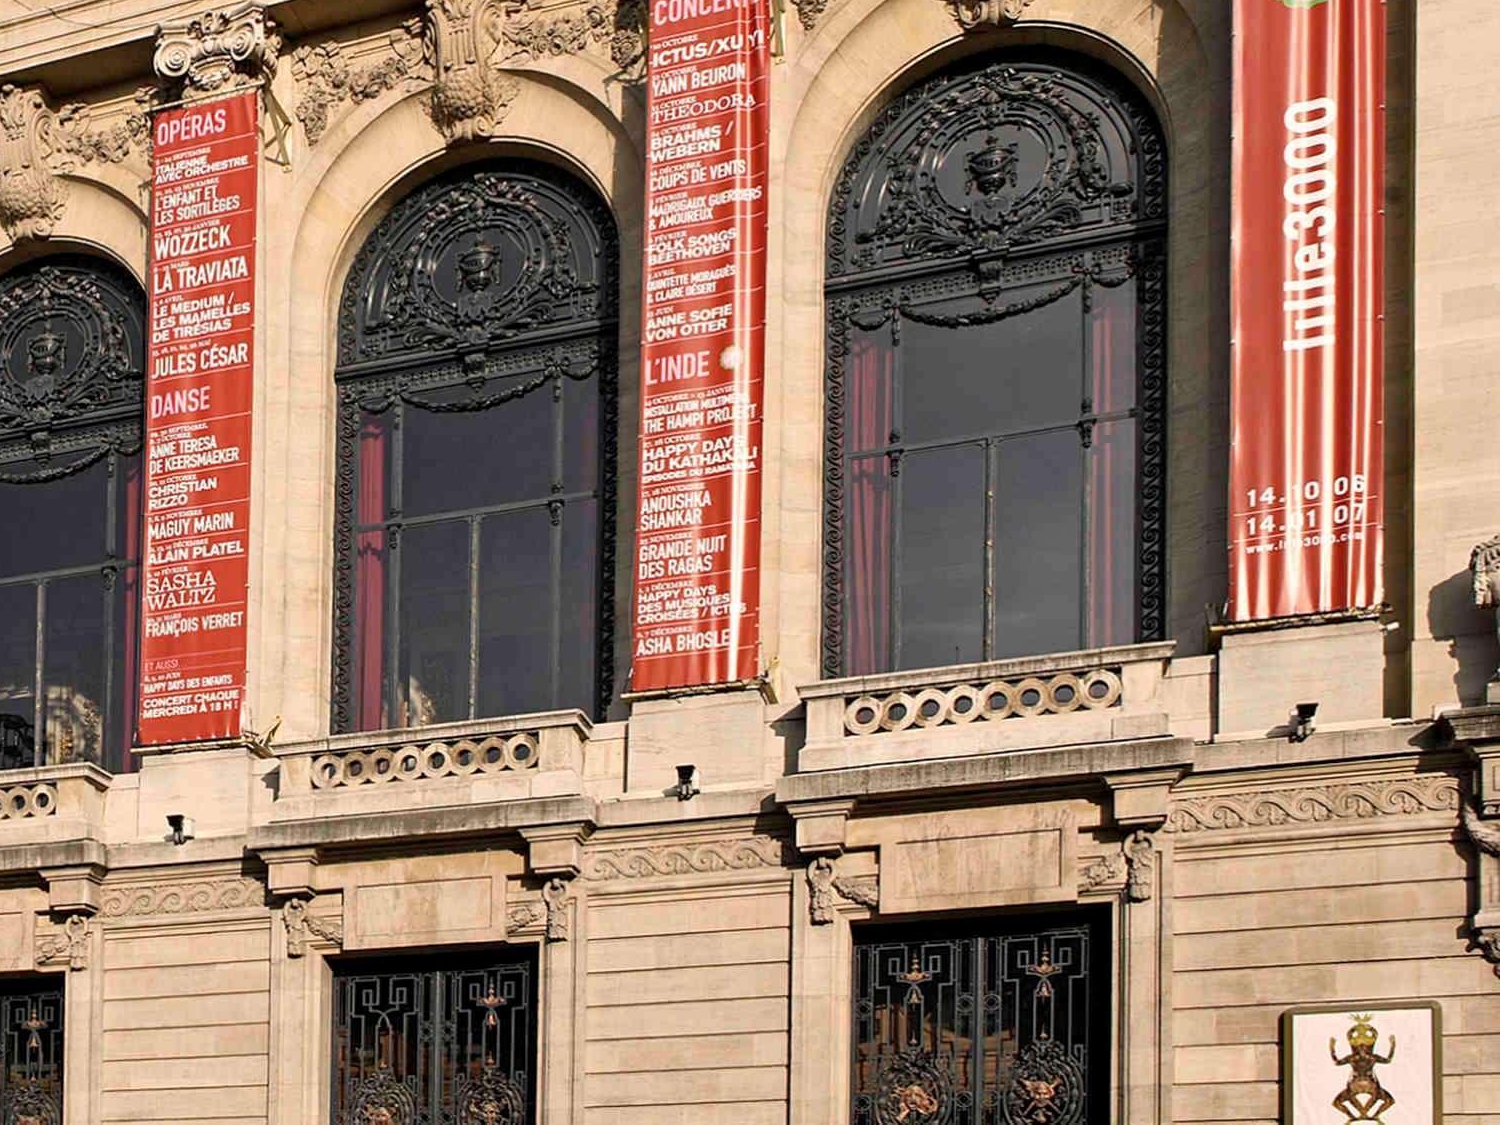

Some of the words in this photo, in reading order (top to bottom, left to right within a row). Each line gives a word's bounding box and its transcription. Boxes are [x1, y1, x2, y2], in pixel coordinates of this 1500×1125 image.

[652, 74, 688, 97] YANN
[691, 62, 746, 89] BEURON
[652, 93, 756, 123] THEODORA
[157, 109, 226, 146] OPÉRAS
[651, 125, 721, 150] BRAHMS
[651, 138, 720, 163] WEBERN
[155, 170, 182, 184] AVEC
[185, 155, 249, 177] ORCHESTRE
[650, 172, 689, 192] COUPS
[691, 167, 707, 183] DE
[709, 159, 746, 179] VENTS
[204, 185, 218, 200] ET
[154, 210, 174, 227] LES
[659, 207, 713, 228] AMOUREUX
[1283, 97, 1337, 352] lille3000
[154, 224, 231, 260] WOZZECK
[648, 238, 685, 254] FOLK
[688, 228, 737, 249] SONGS
[648, 241, 731, 266] BEETHOVEN
[153, 270, 173, 294] LA
[178, 256, 248, 288] TRAVIATA
[655, 286, 685, 302] CLAIRE
[153, 305, 168, 319] LE
[171, 295, 225, 314] MEDIUM
[153, 317, 176, 331] LES
[180, 302, 250, 325] MAMELLES
[646, 312, 687, 331] ANNE
[689, 303, 732, 322] SOFIE
[153, 330, 170, 343] DE
[645, 327, 676, 342] VON
[680, 318, 728, 336] OTTER
[152, 352, 196, 379] JULES
[200, 343, 248, 370] CÉSAR
[645, 350, 710, 386] L'INDE
[151, 386, 211, 419] DANSE
[644, 416, 665, 434] THE
[667, 412, 704, 430] HAMPI
[150, 441, 177, 459] ANNE
[179, 435, 218, 454] TERESA
[643, 442, 698, 461] HAPPY
[702, 435, 745, 453] DAYS
[149, 459, 163, 475] DE
[165, 447, 239, 473] KEERSMAEKER
[642, 460, 665, 474] DU
[148, 477, 217, 498] CHRISTIAN
[1246, 475, 1364, 508] 14.1006
[149, 493, 188, 510] RIZZO
[640, 490, 712, 515] ANOUSHKA
[148, 518, 190, 539] MAGUY
[194, 512, 234, 533] MARIN
[640, 508, 702, 531] SHANKAR
[1246, 504, 1364, 536] 14.0107
[148, 548, 189, 565] ALAIN
[193, 540, 244, 558] PLATEL
[639, 539, 692, 562] GRANDE
[697, 534, 727, 555] NUIT
[639, 561, 664, 579] DES
[668, 555, 713, 576] RAGAS
[147, 570, 216, 594] SASHA
[638, 589, 680, 603] HAPPY
[684, 584, 716, 598] DAYS
[147, 587, 216, 611] WALTZ
[638, 602, 662, 614] DES
[666, 593, 730, 610] MUSIQUES
[711, 602, 747, 616] ICTS
[146, 617, 198, 638] FRANÇOIS
[202, 611, 243, 630] VERRET
[636, 637, 673, 656] ASHA
[677, 629, 731, 651] BHOSLE
[143, 695, 192, 708] CONCERT
[195, 690, 239, 703] CHAQUE
[144, 680, 166, 694] HAPPY
[143, 705, 197, 719] MERCREDI
